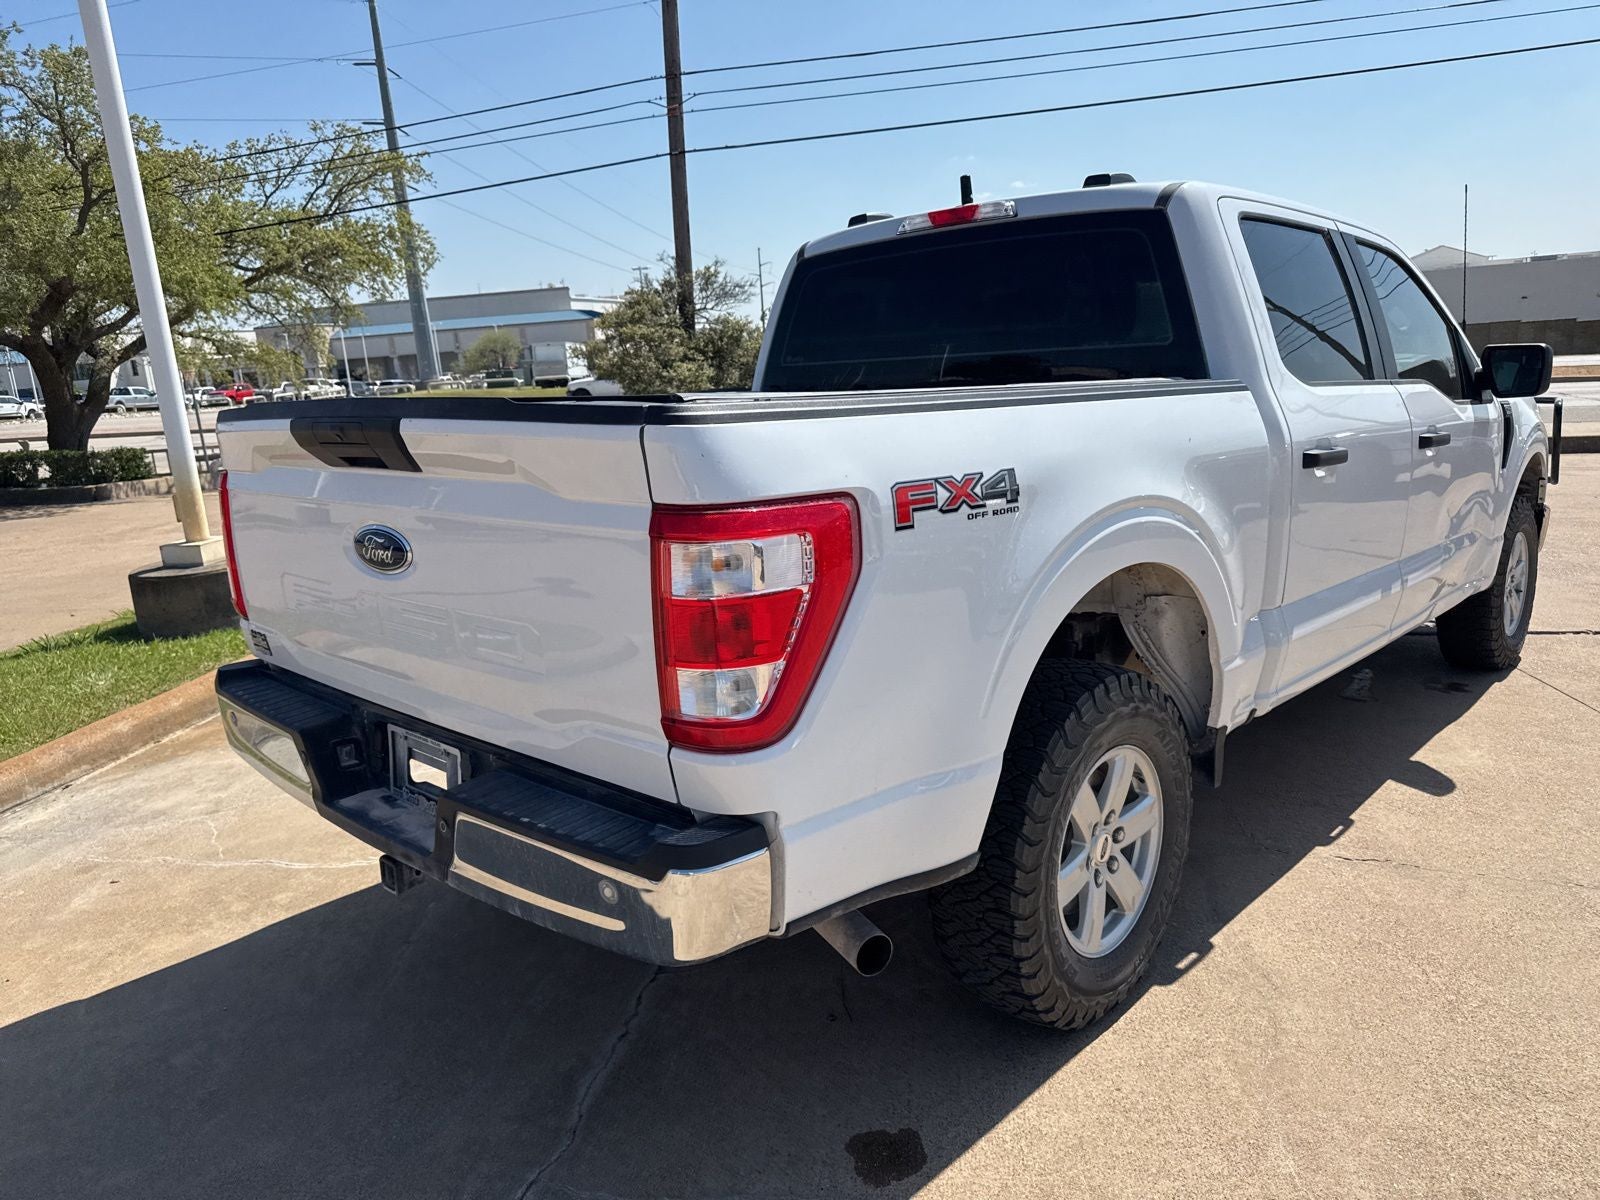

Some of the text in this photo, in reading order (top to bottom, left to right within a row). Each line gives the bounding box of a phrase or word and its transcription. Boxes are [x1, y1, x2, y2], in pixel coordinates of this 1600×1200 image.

[890, 467, 1020, 532] FX4
[967, 505, 1020, 520] OFF ROAD
[363, 534, 394, 563] Ford
